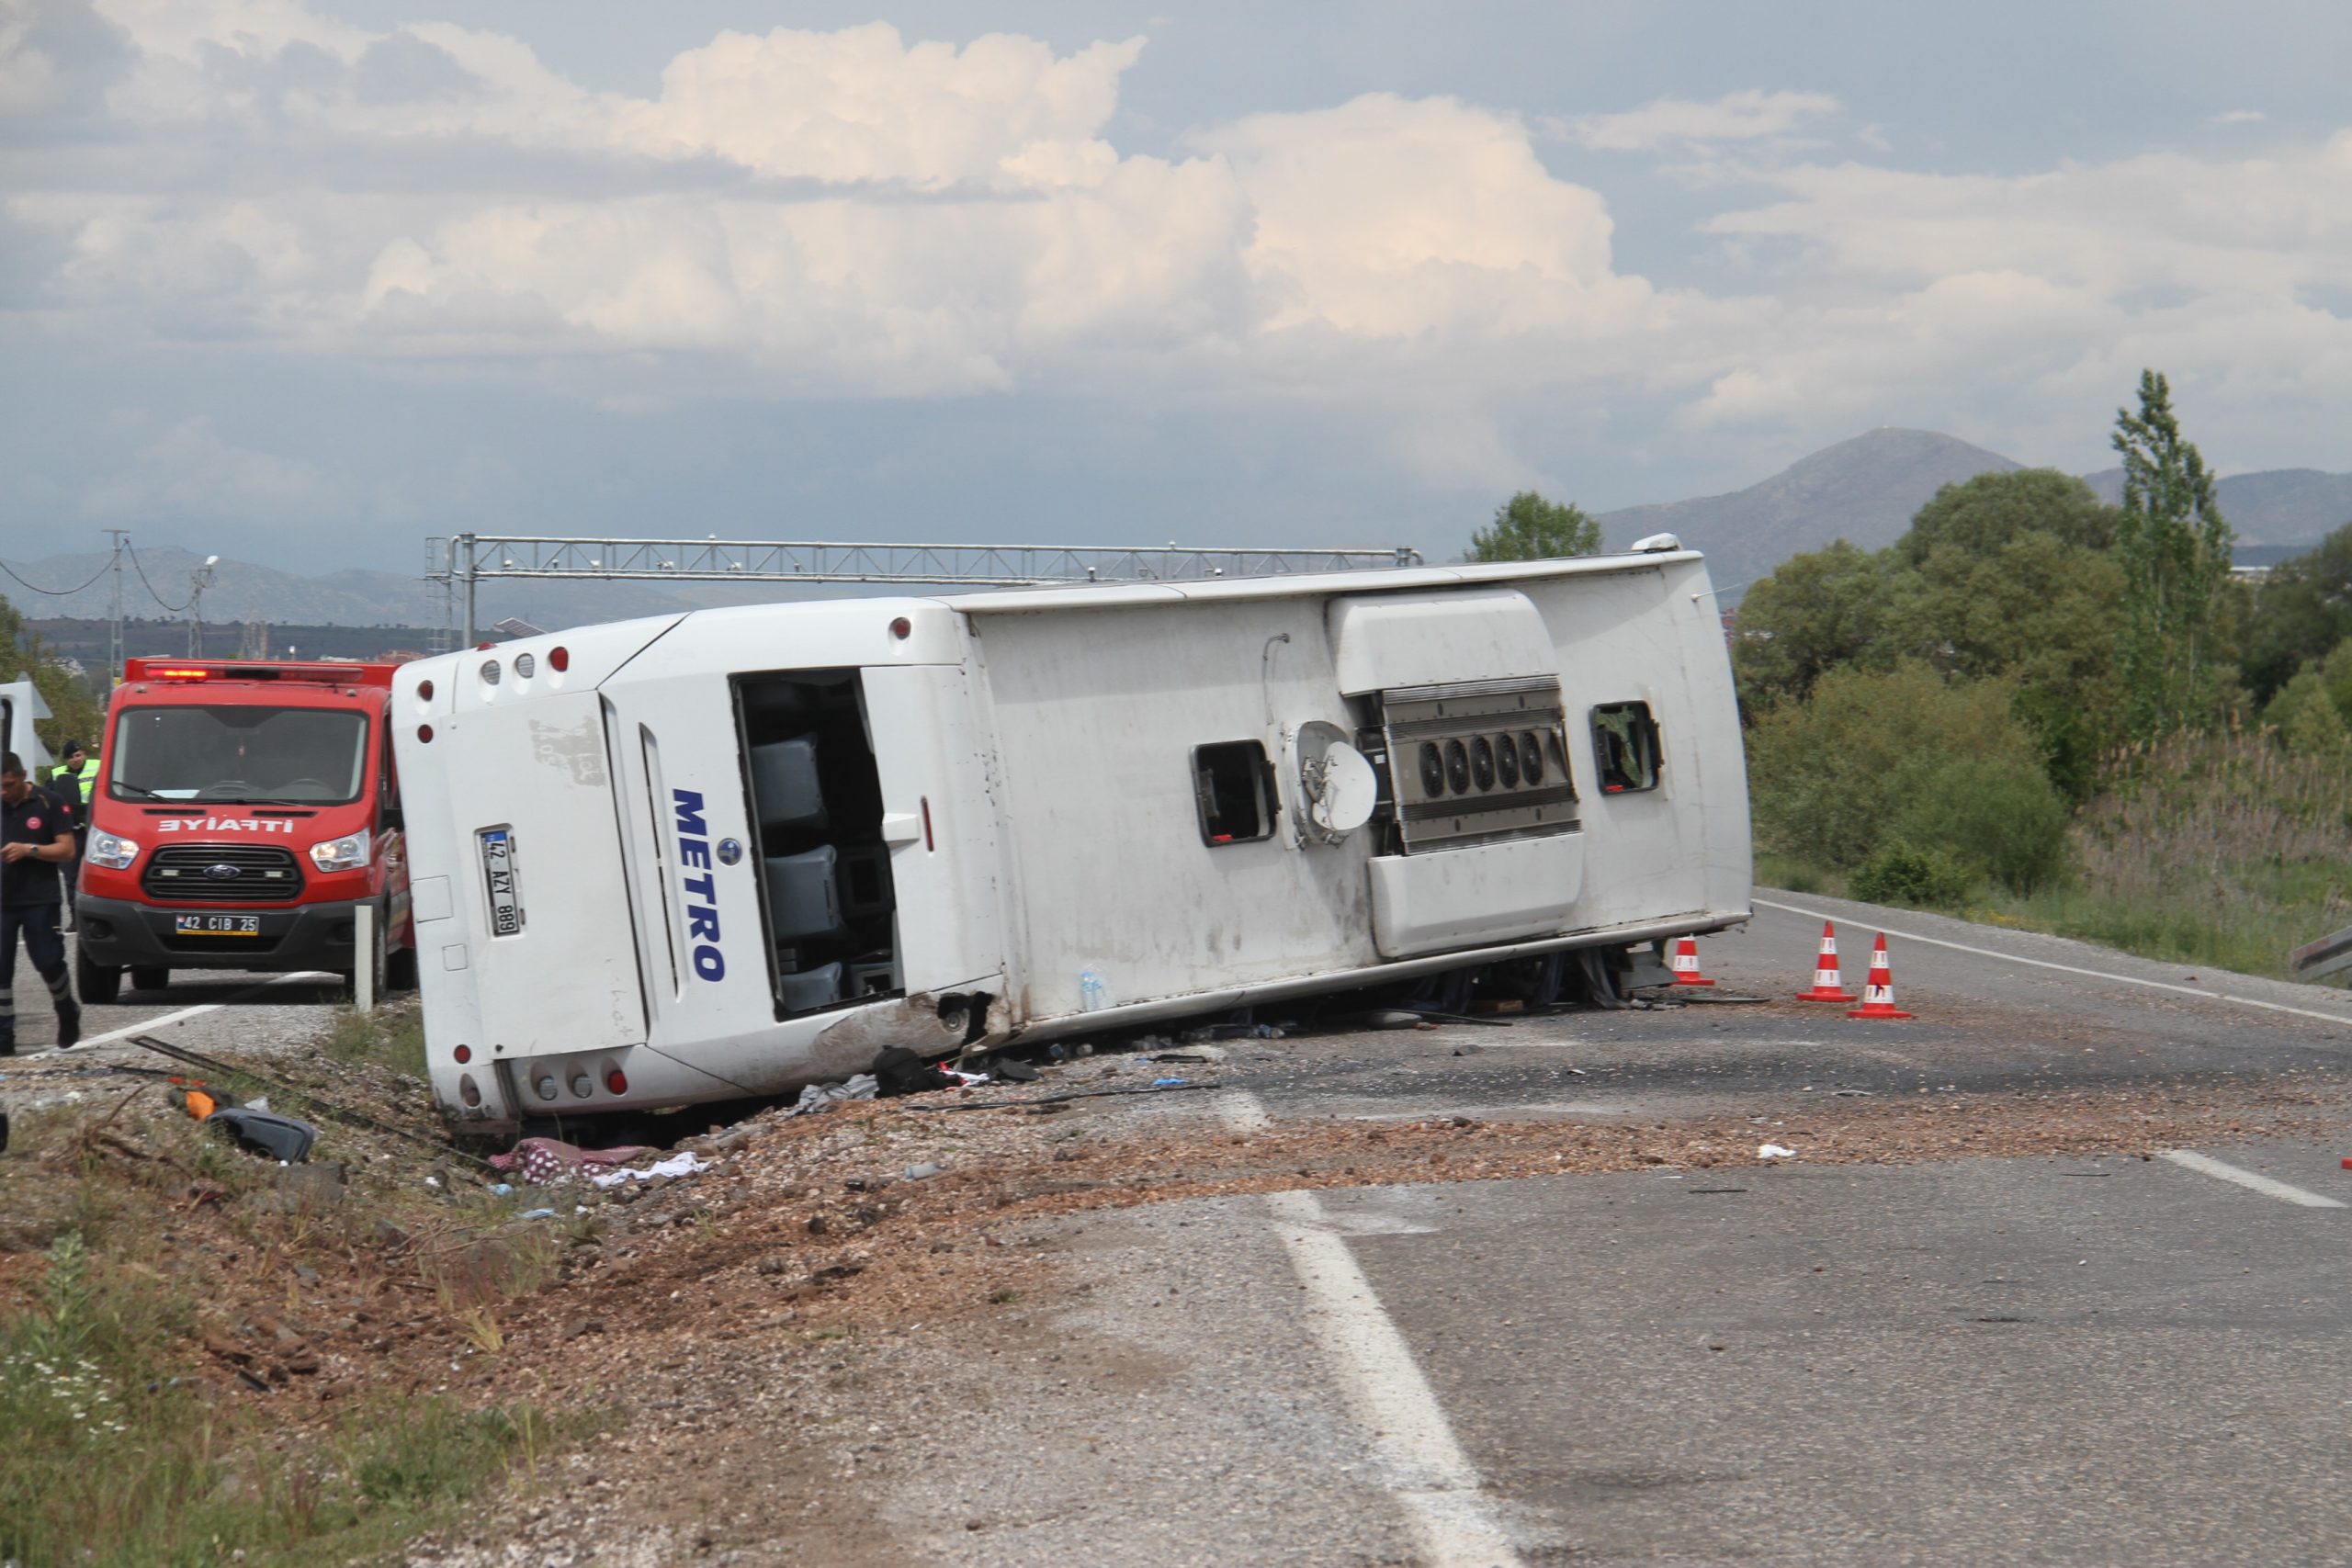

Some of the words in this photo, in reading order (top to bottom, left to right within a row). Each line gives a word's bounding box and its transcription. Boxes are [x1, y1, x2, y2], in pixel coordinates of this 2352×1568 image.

[489, 842, 506, 860] 42
[492, 871, 512, 894] AZY
[673, 788, 725, 983] METRO
[185, 916, 200, 930] 42
[208, 917, 232, 931] CIB
[240, 919, 255, 931] 25
[497, 905, 515, 931] 889
